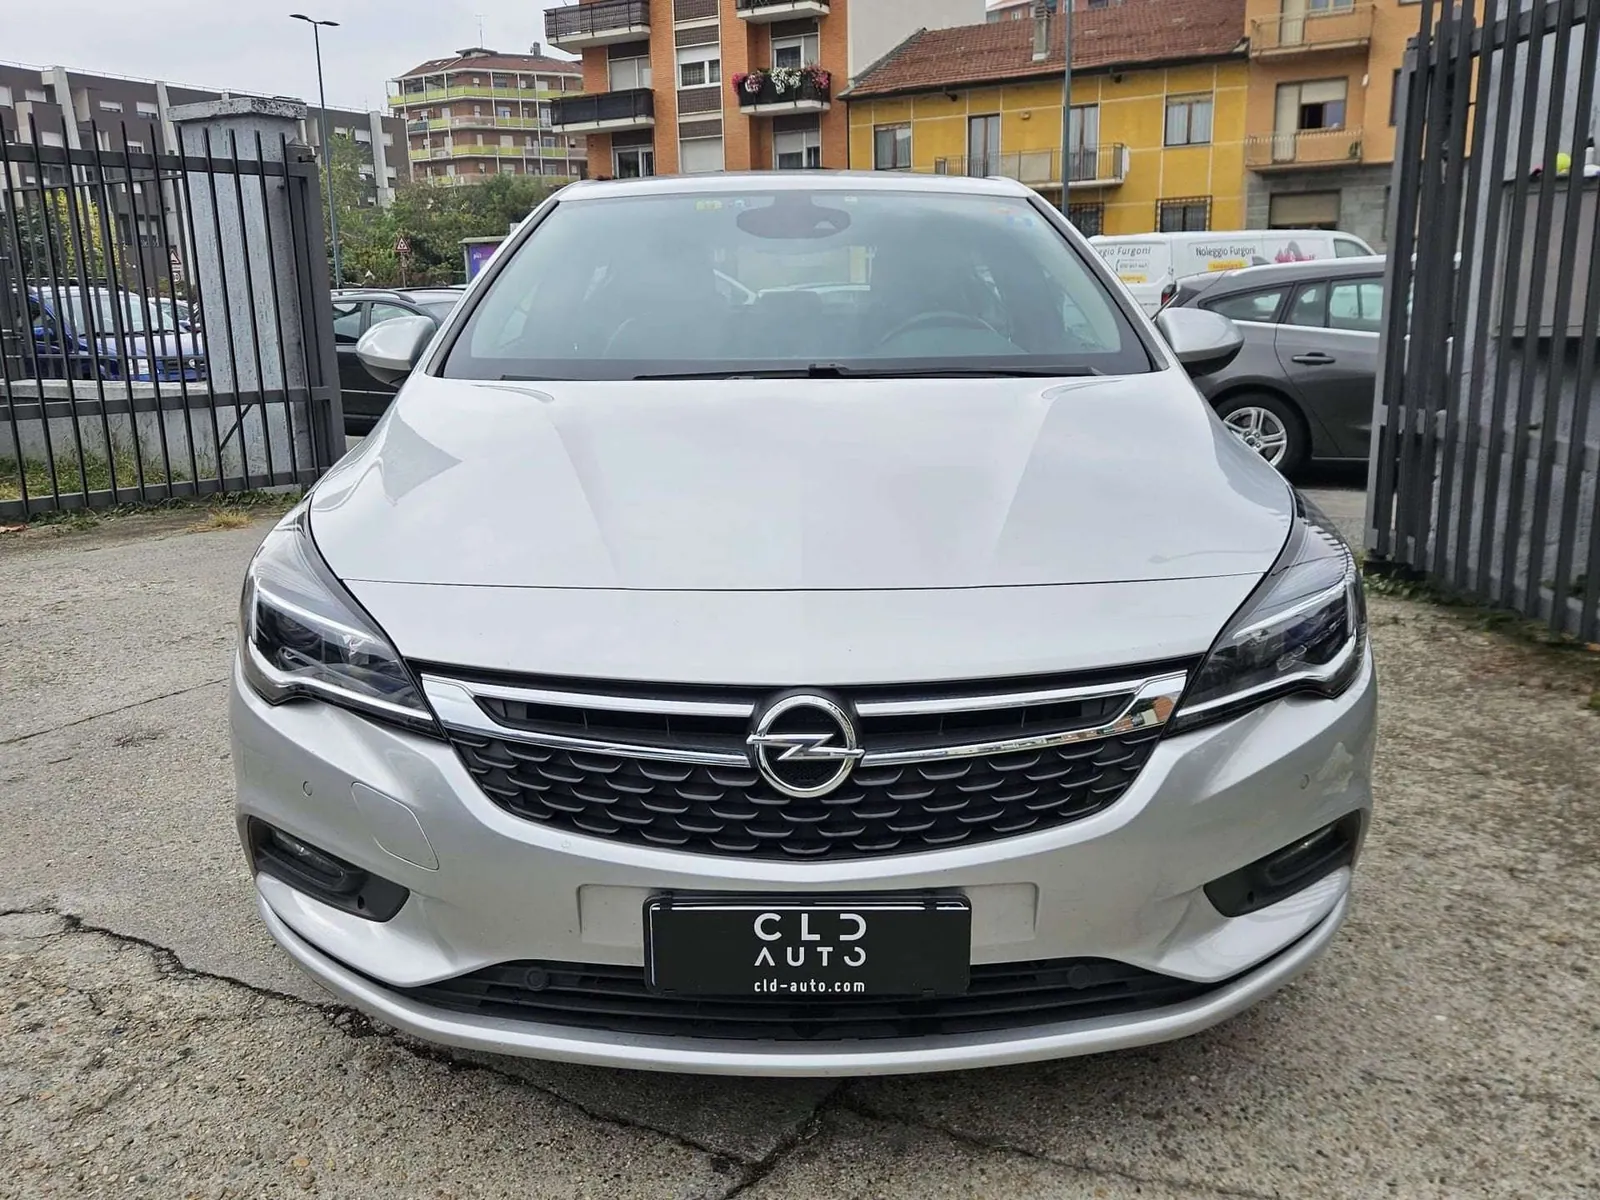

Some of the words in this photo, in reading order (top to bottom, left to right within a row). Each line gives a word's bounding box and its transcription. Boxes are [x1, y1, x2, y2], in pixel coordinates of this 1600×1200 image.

[1117, 246, 1151, 257] Furgoni
[1195, 246, 1228, 258] Noleggio
[1229, 246, 1256, 257] Furgoni
[753, 912, 867, 941] CLD
[753, 946, 867, 967] AUTO
[754, 978, 865, 992] cld-auto.com
